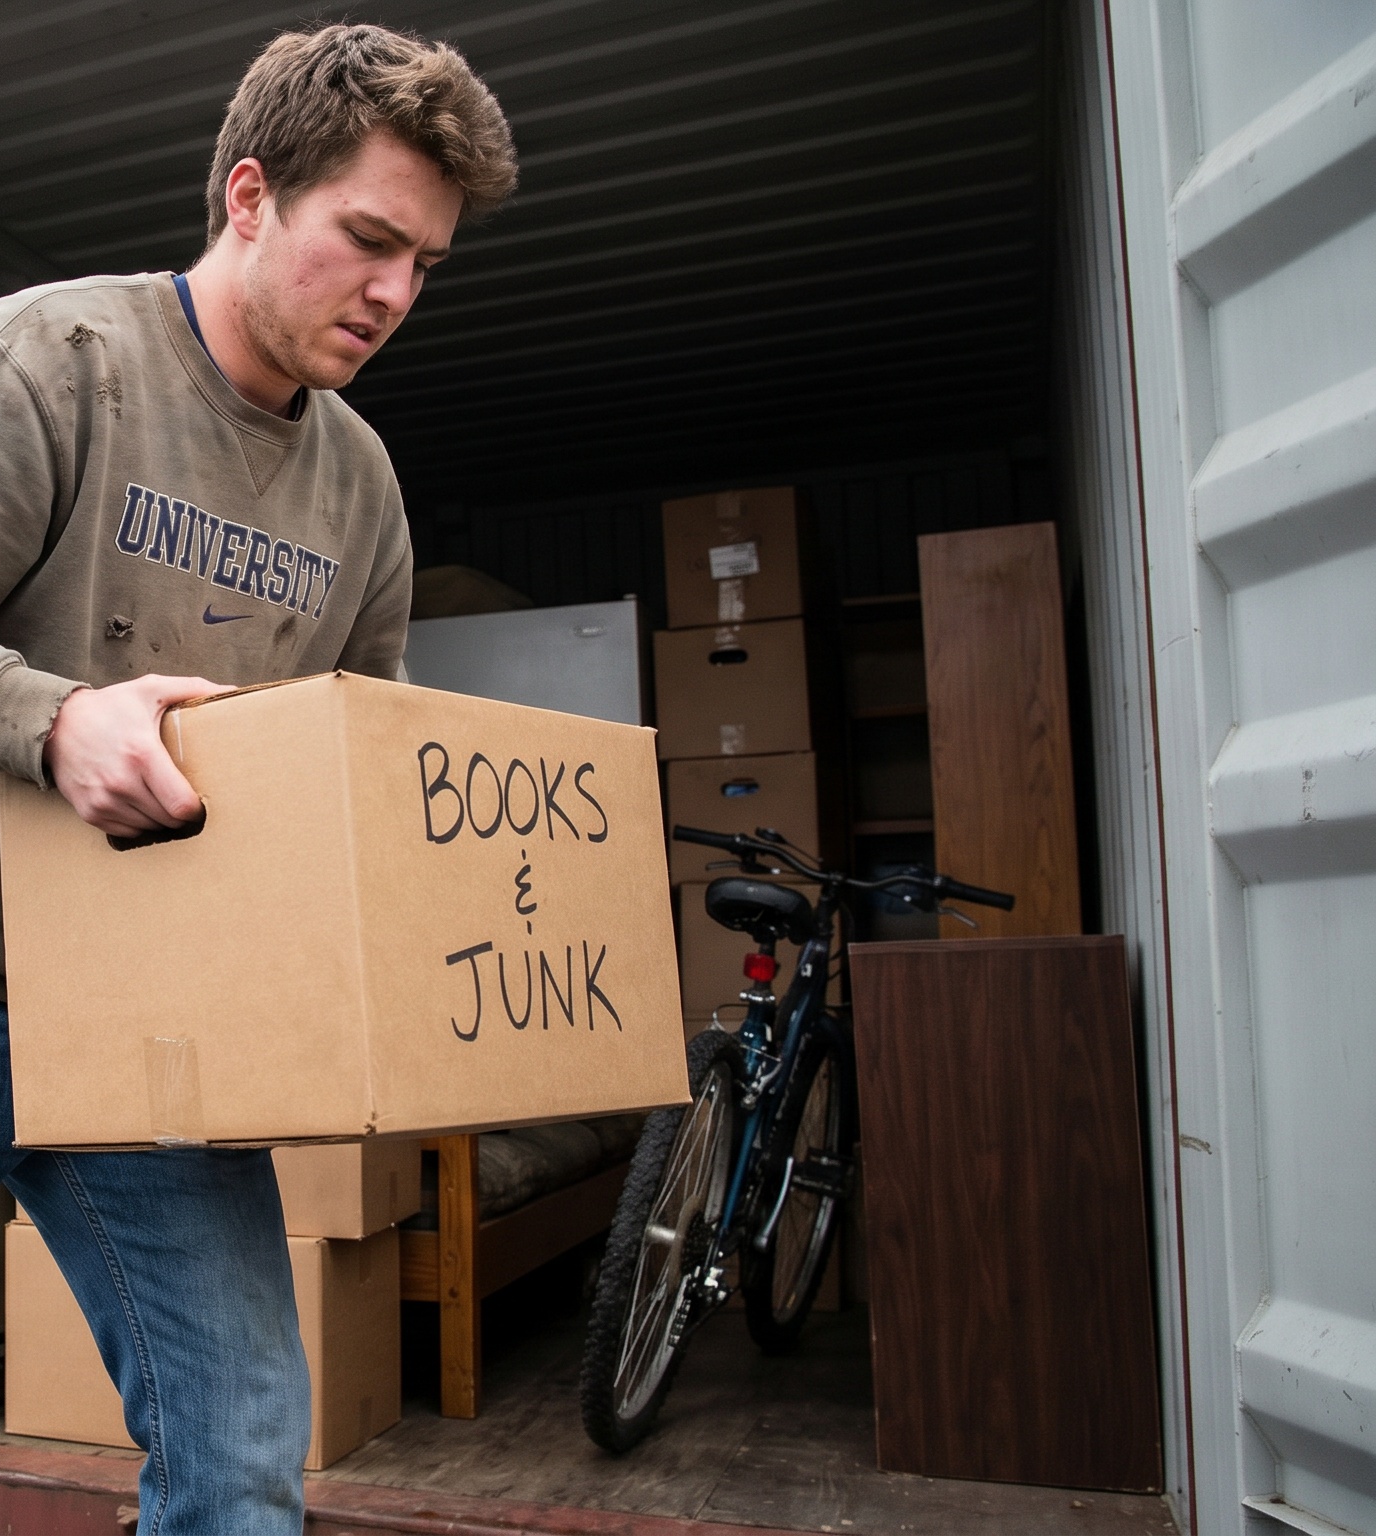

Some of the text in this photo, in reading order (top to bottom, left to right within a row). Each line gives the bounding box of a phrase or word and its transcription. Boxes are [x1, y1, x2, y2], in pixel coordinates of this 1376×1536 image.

[115, 482, 340, 621] UNIVERSITY
[417, 741, 609, 844] BOOKS
[514, 848, 538, 935] &
[445, 940, 623, 1042] JUNK
